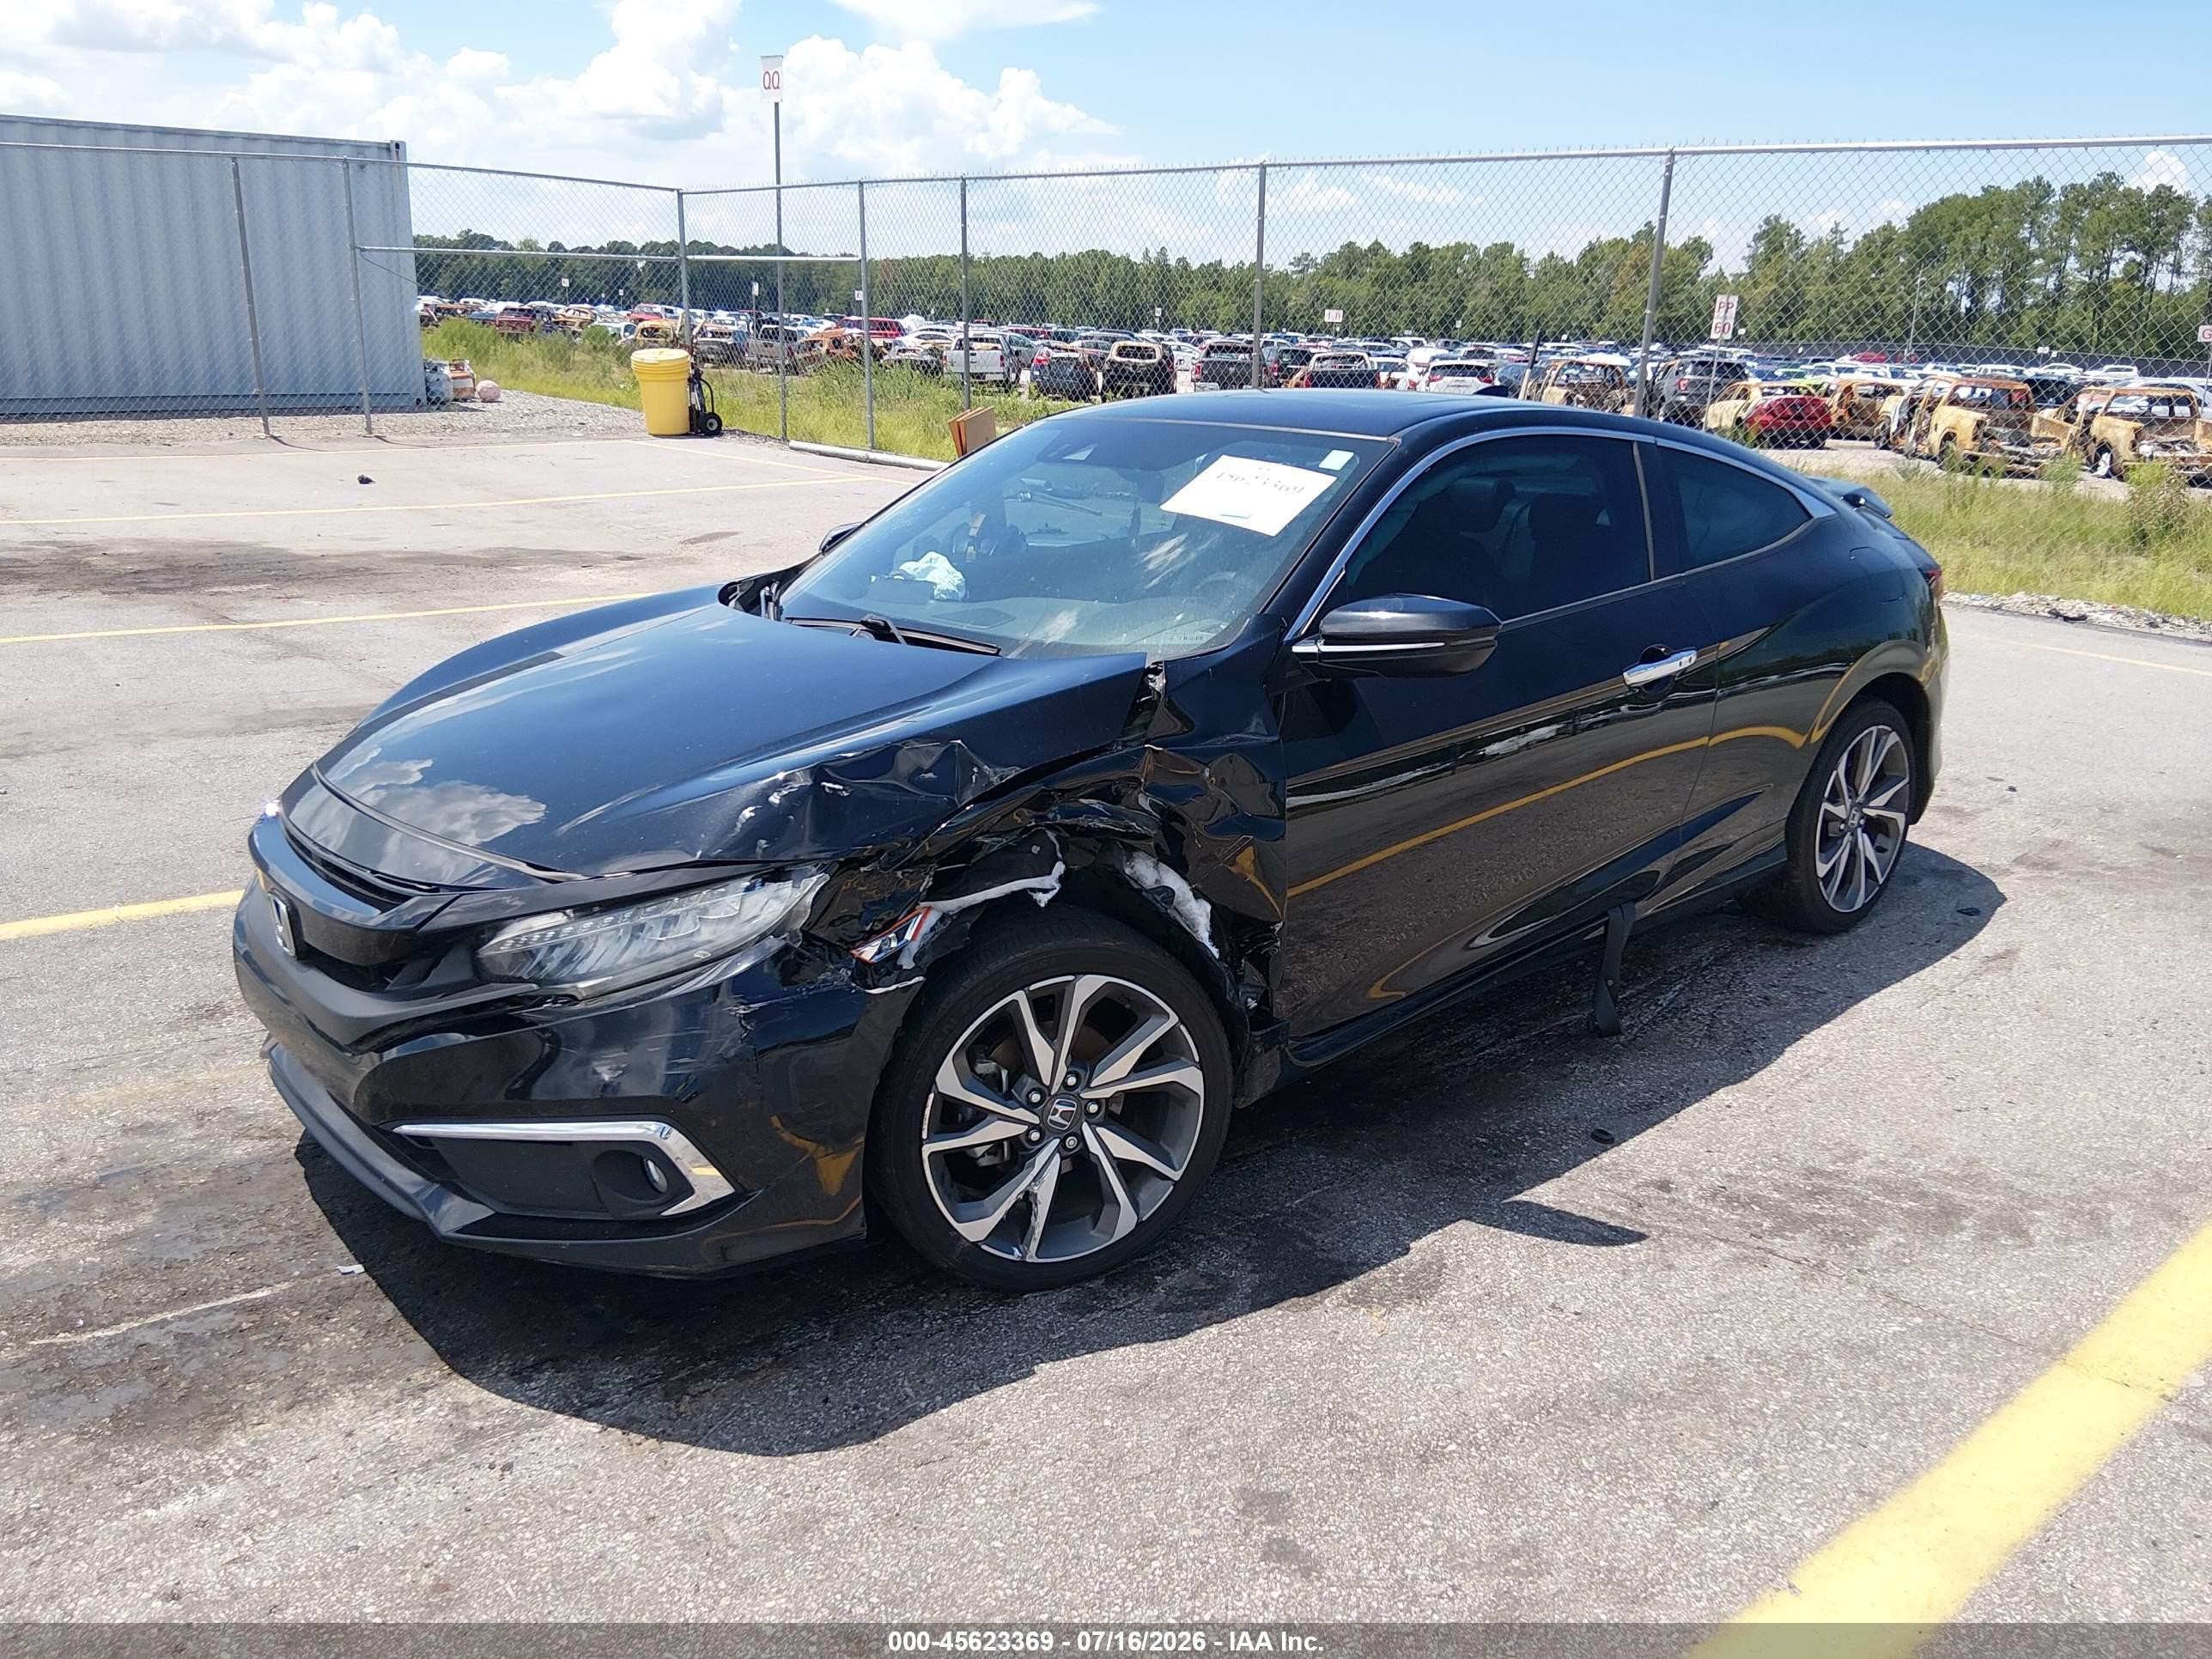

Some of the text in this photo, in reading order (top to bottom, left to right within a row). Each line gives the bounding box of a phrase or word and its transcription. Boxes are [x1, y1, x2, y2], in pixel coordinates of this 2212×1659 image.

[763, 70, 781, 90] QQ
[1717, 301, 1735, 313] PP
[1714, 322, 1731, 335] 60
